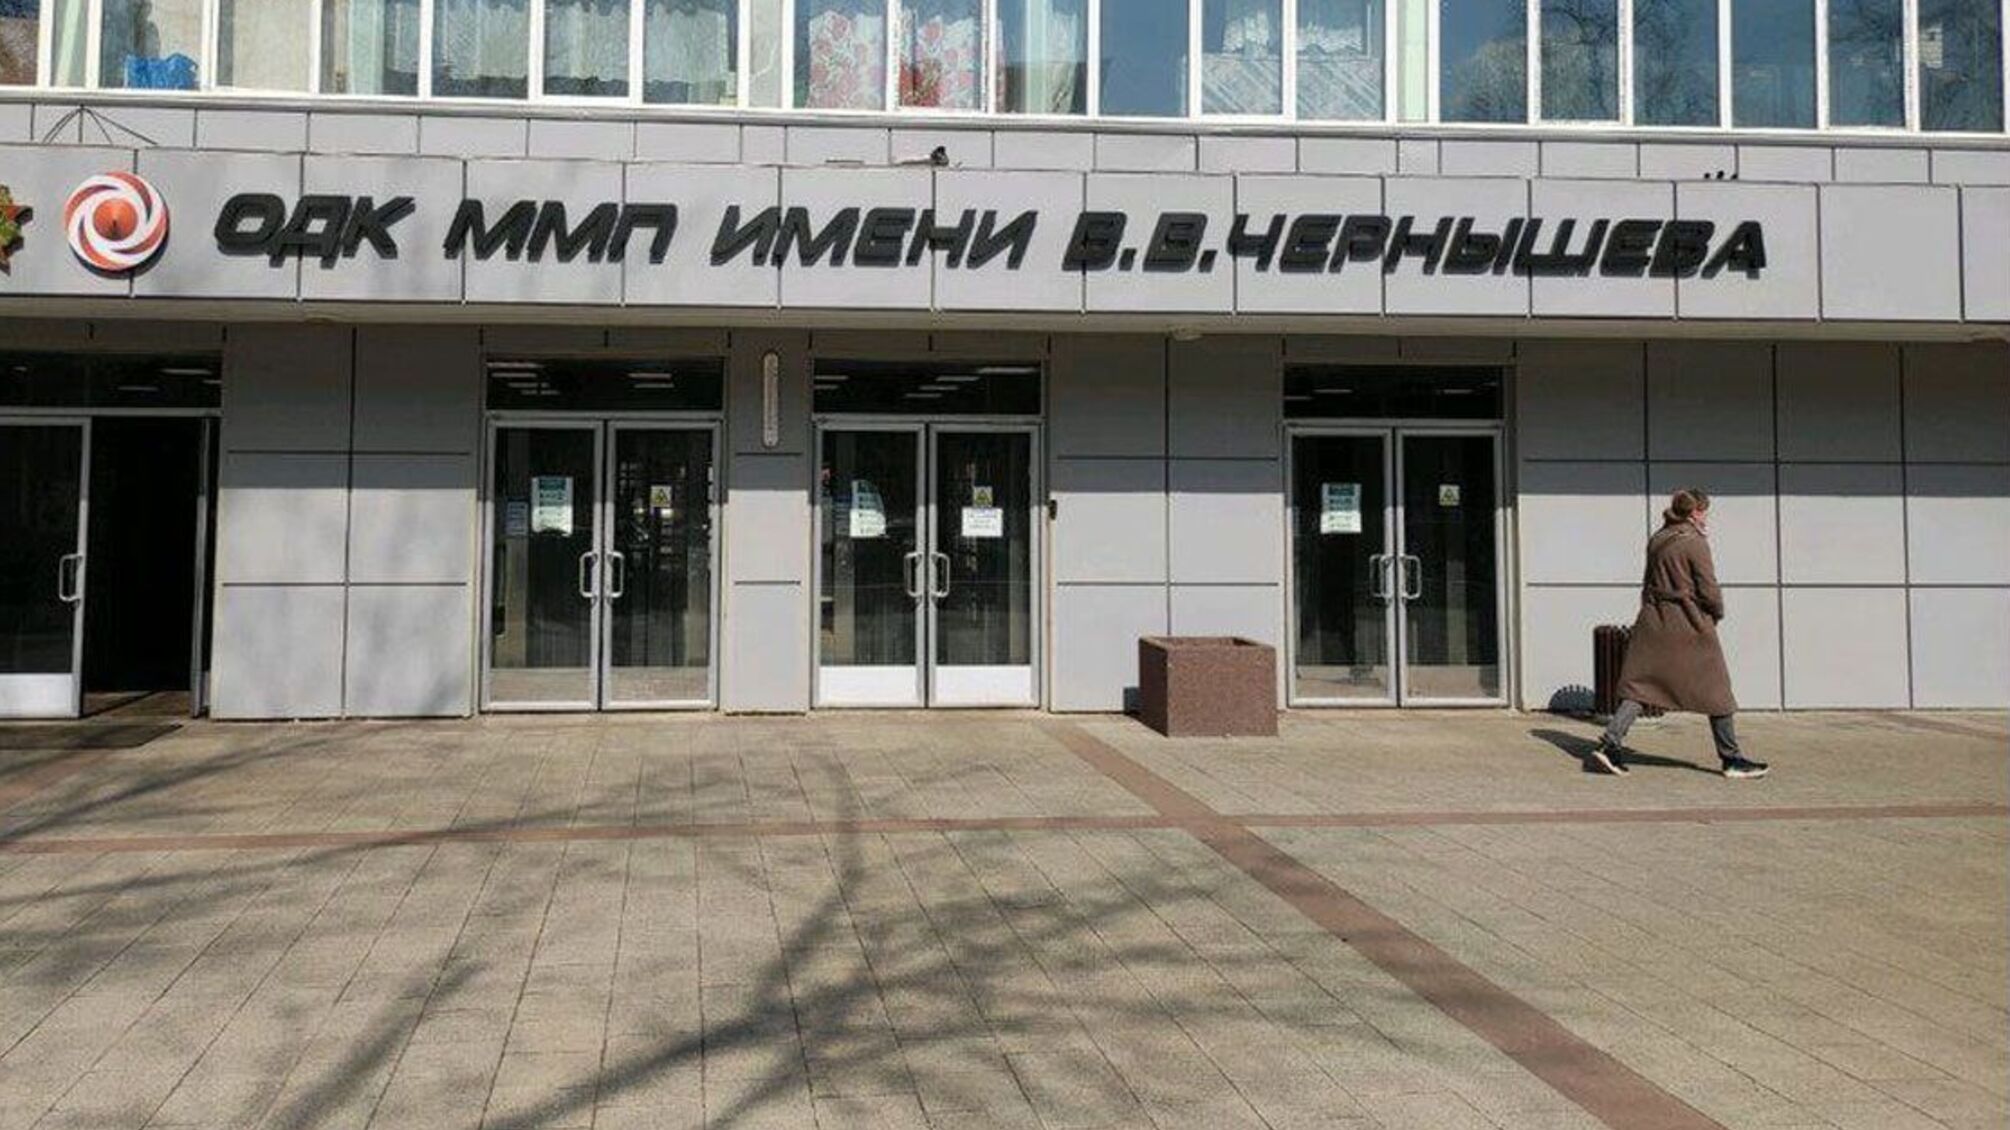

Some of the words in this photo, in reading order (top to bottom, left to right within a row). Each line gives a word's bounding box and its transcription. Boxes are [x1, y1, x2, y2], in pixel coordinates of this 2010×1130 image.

[214, 193, 415, 269] ОДК
[443, 199, 678, 264] ММП
[710, 205, 1038, 270] ИМЕНИ
[1062, 211, 1218, 273] В.В.
[1227, 214, 1768, 279] ЧЕРНЫШЕВА
